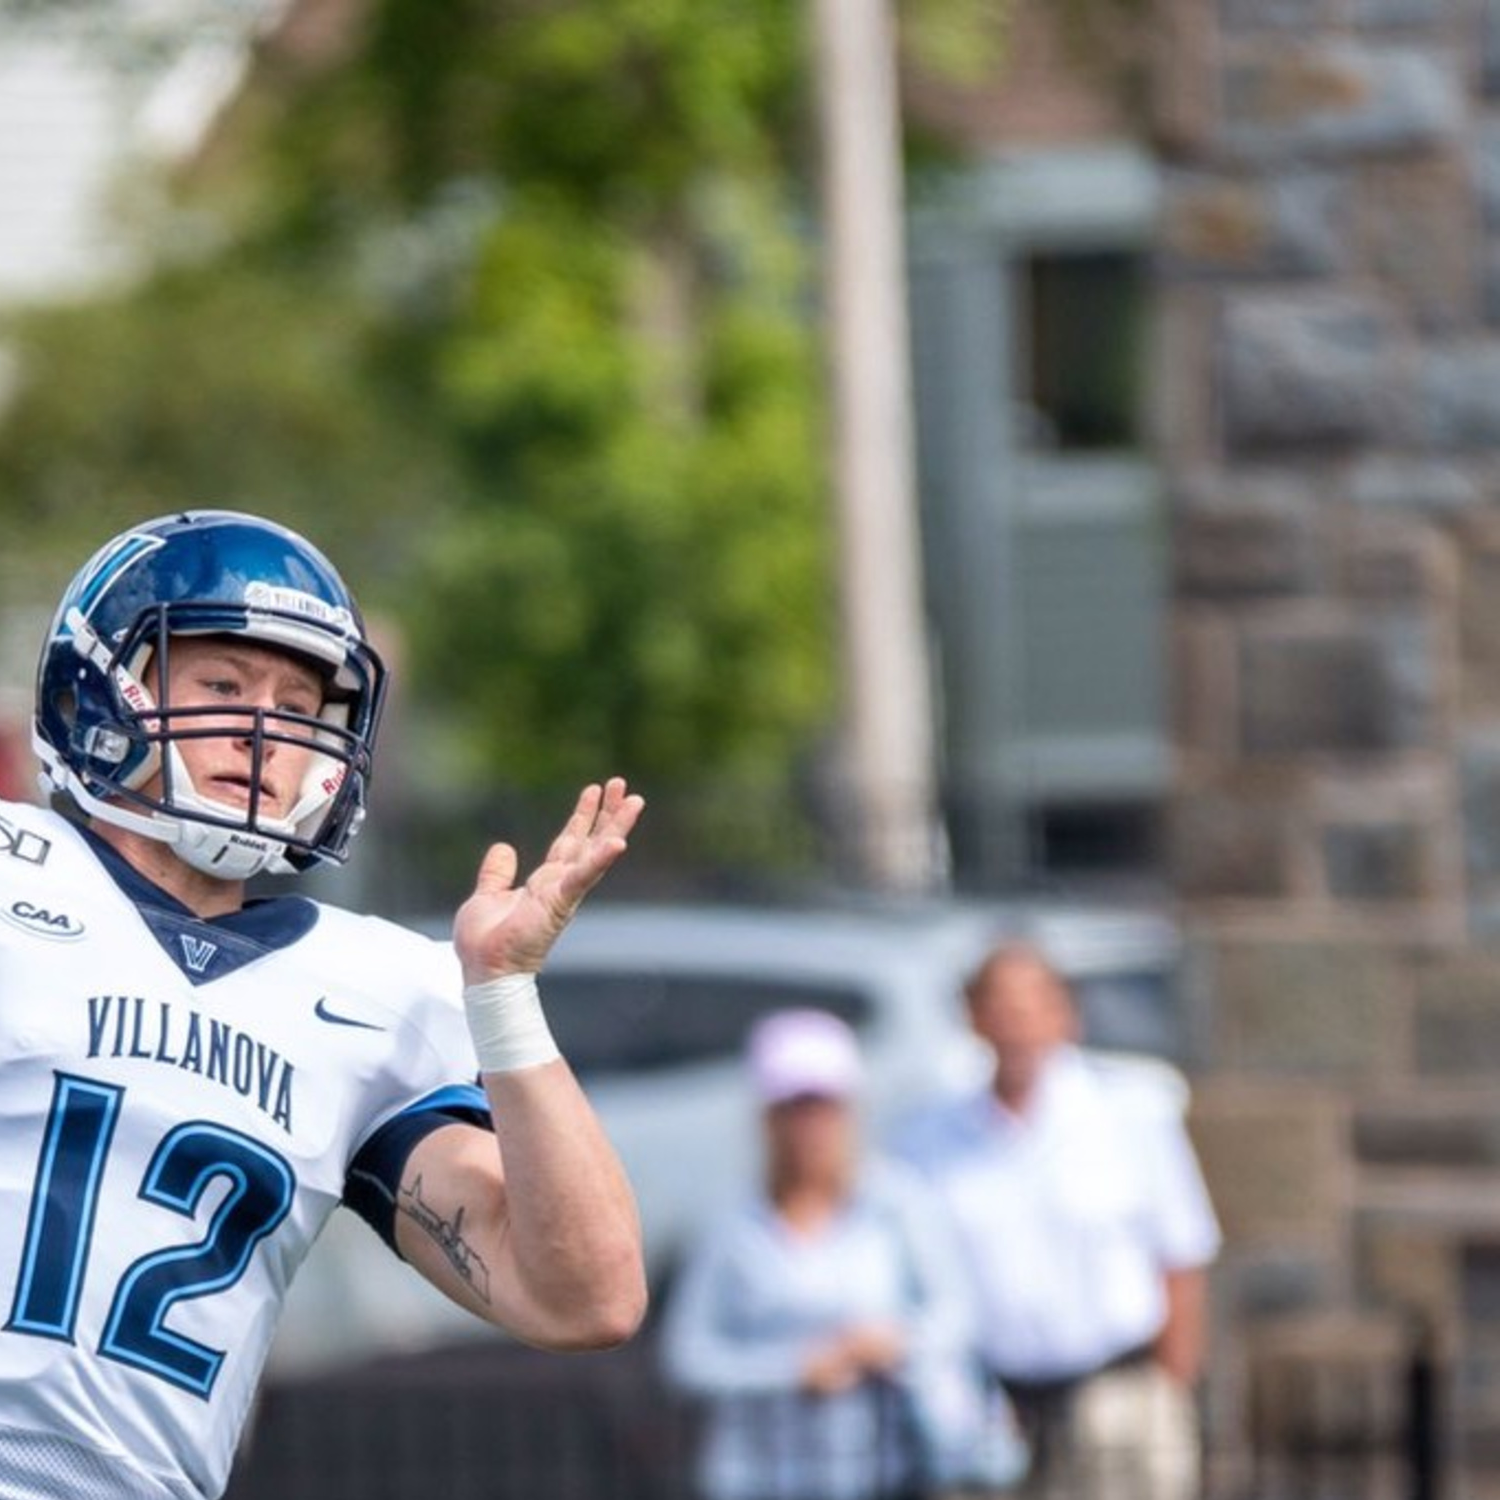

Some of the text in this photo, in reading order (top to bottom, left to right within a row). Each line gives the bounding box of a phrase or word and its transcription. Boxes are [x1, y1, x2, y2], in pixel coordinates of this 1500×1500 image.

[11, 900, 71, 930] CAA
[180, 934, 217, 972] V
[86, 996, 295, 1136] VILLANOVA
[1, 1069, 298, 1402] 12
